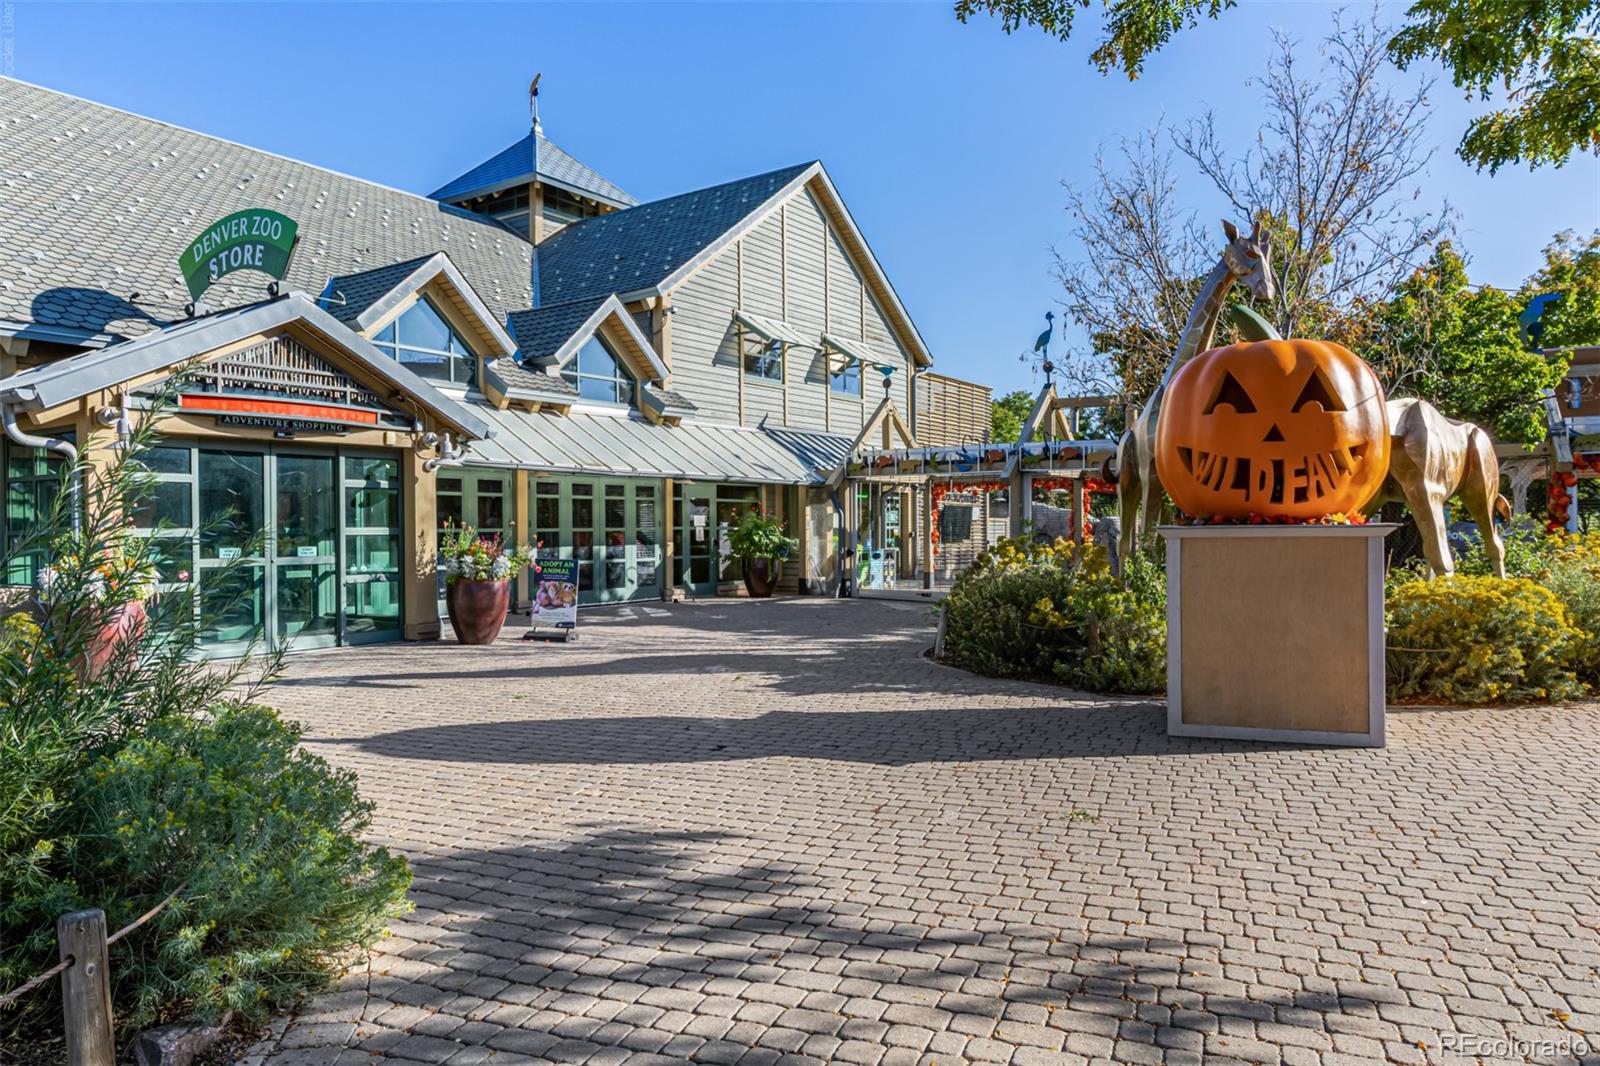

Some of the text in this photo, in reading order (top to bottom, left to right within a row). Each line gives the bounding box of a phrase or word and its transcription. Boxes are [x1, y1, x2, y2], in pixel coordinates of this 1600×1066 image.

[193, 216, 282, 262] DENVER ZOO
[209, 244, 264, 279] STORE
[224, 415, 343, 431] ADVENTURE SHOPPING
